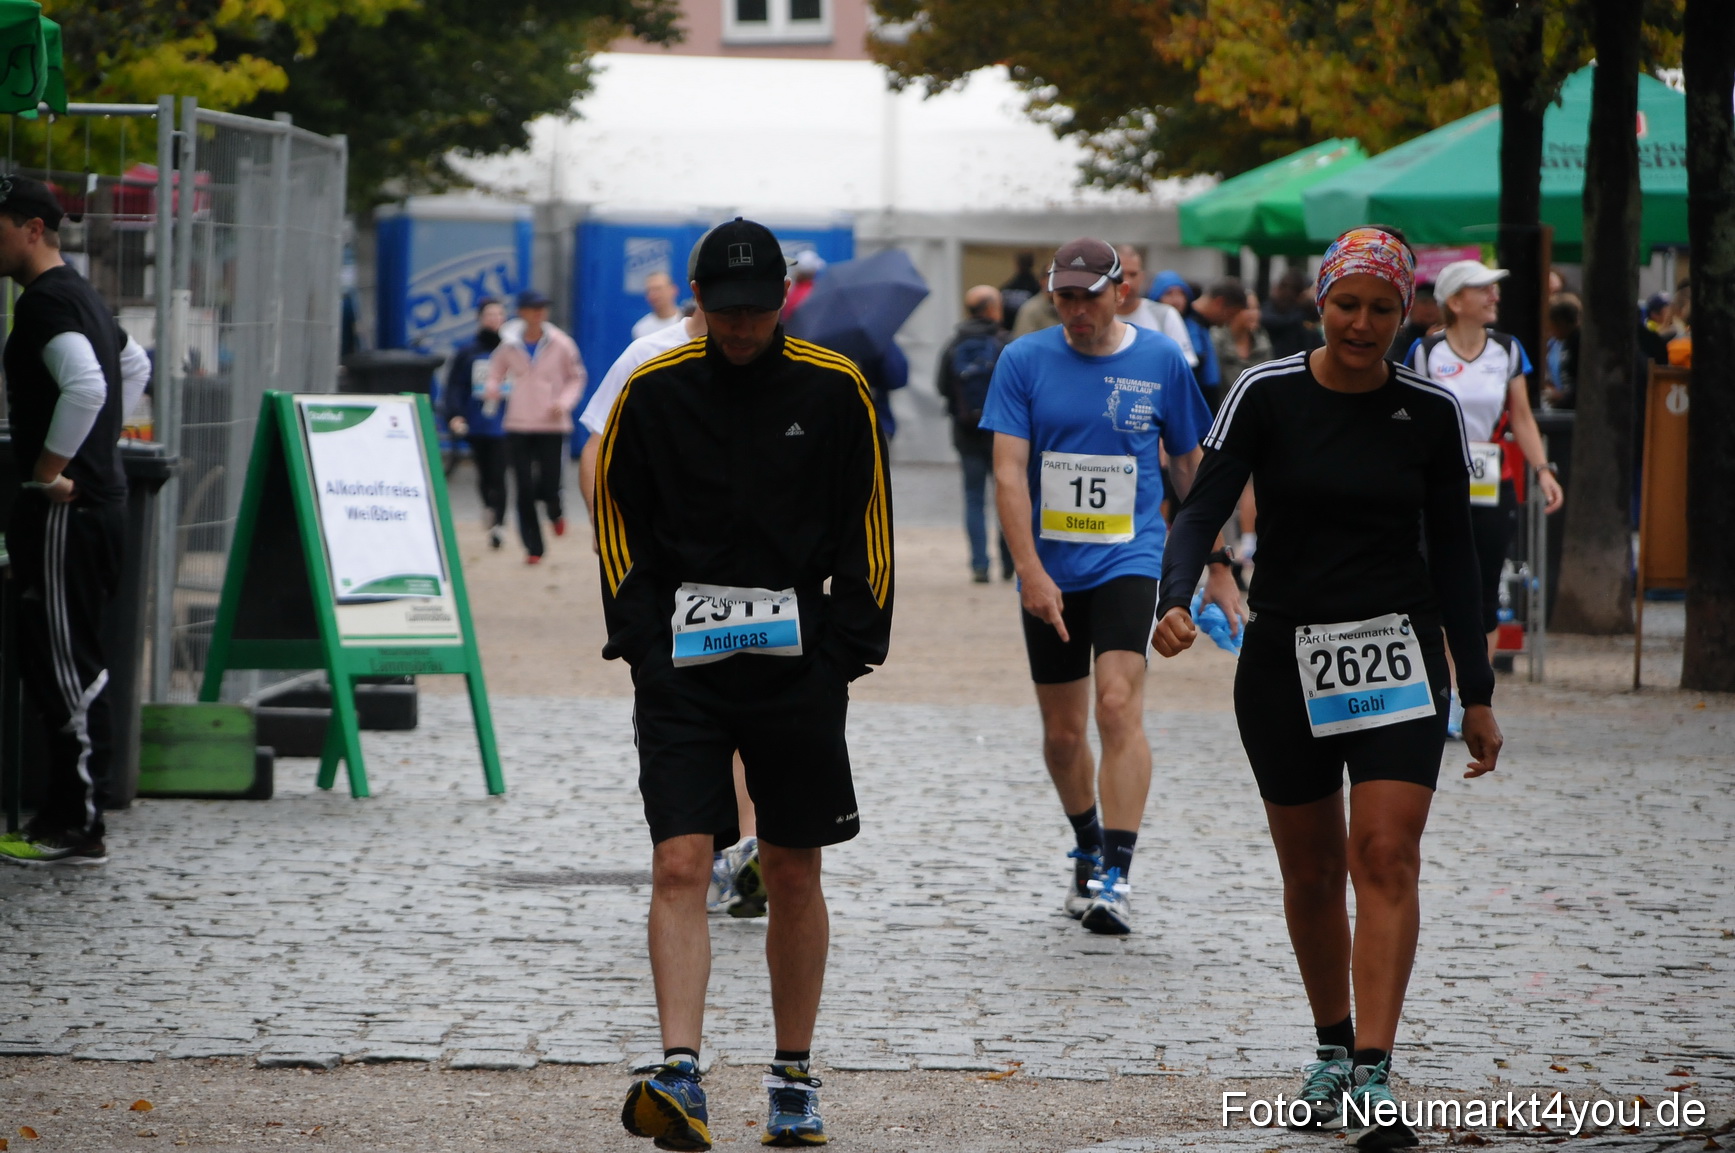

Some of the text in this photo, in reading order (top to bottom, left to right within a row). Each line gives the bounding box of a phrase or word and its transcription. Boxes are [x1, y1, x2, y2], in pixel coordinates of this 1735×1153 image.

[1114, 384, 1153, 395] STADTLAUF
[1116, 378, 1162, 391] NEUMARKTER
[1043, 460, 1120, 473] PARTL Neumarkt
[325, 479, 421, 498] Alkoholfreies
[1069, 476, 1107, 509] 15
[344, 505, 409, 522] Weißbier
[1066, 516, 1105, 530] Stefan
[703, 632, 768, 652] Andreas
[1298, 626, 1396, 647] PARTL Neumarkt
[1310, 641, 1412, 691] 2626
[1348, 694, 1386, 714] Gabi
